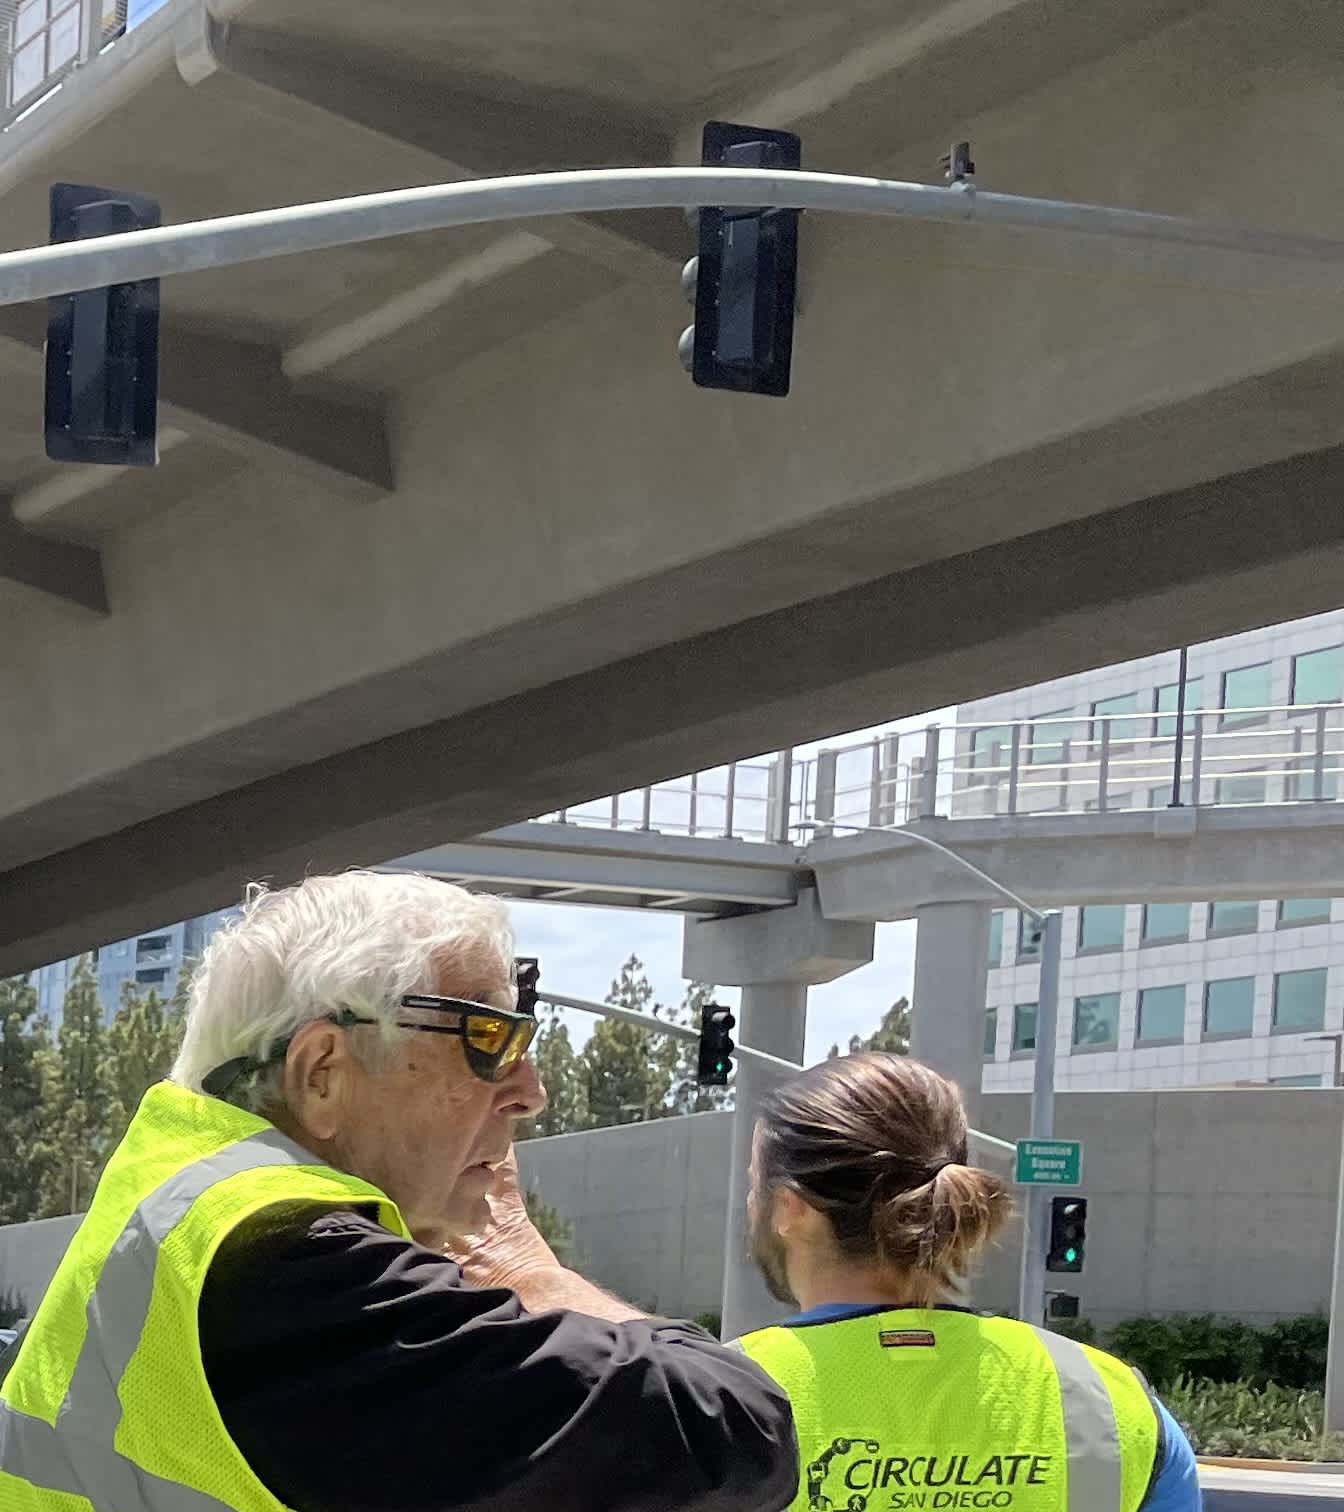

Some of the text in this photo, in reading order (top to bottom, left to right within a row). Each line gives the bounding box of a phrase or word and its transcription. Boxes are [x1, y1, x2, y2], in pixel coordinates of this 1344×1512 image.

[844, 1455, 1052, 1490] CIRCULATE
[888, 1491, 1013, 1509] SAN DIEGO
